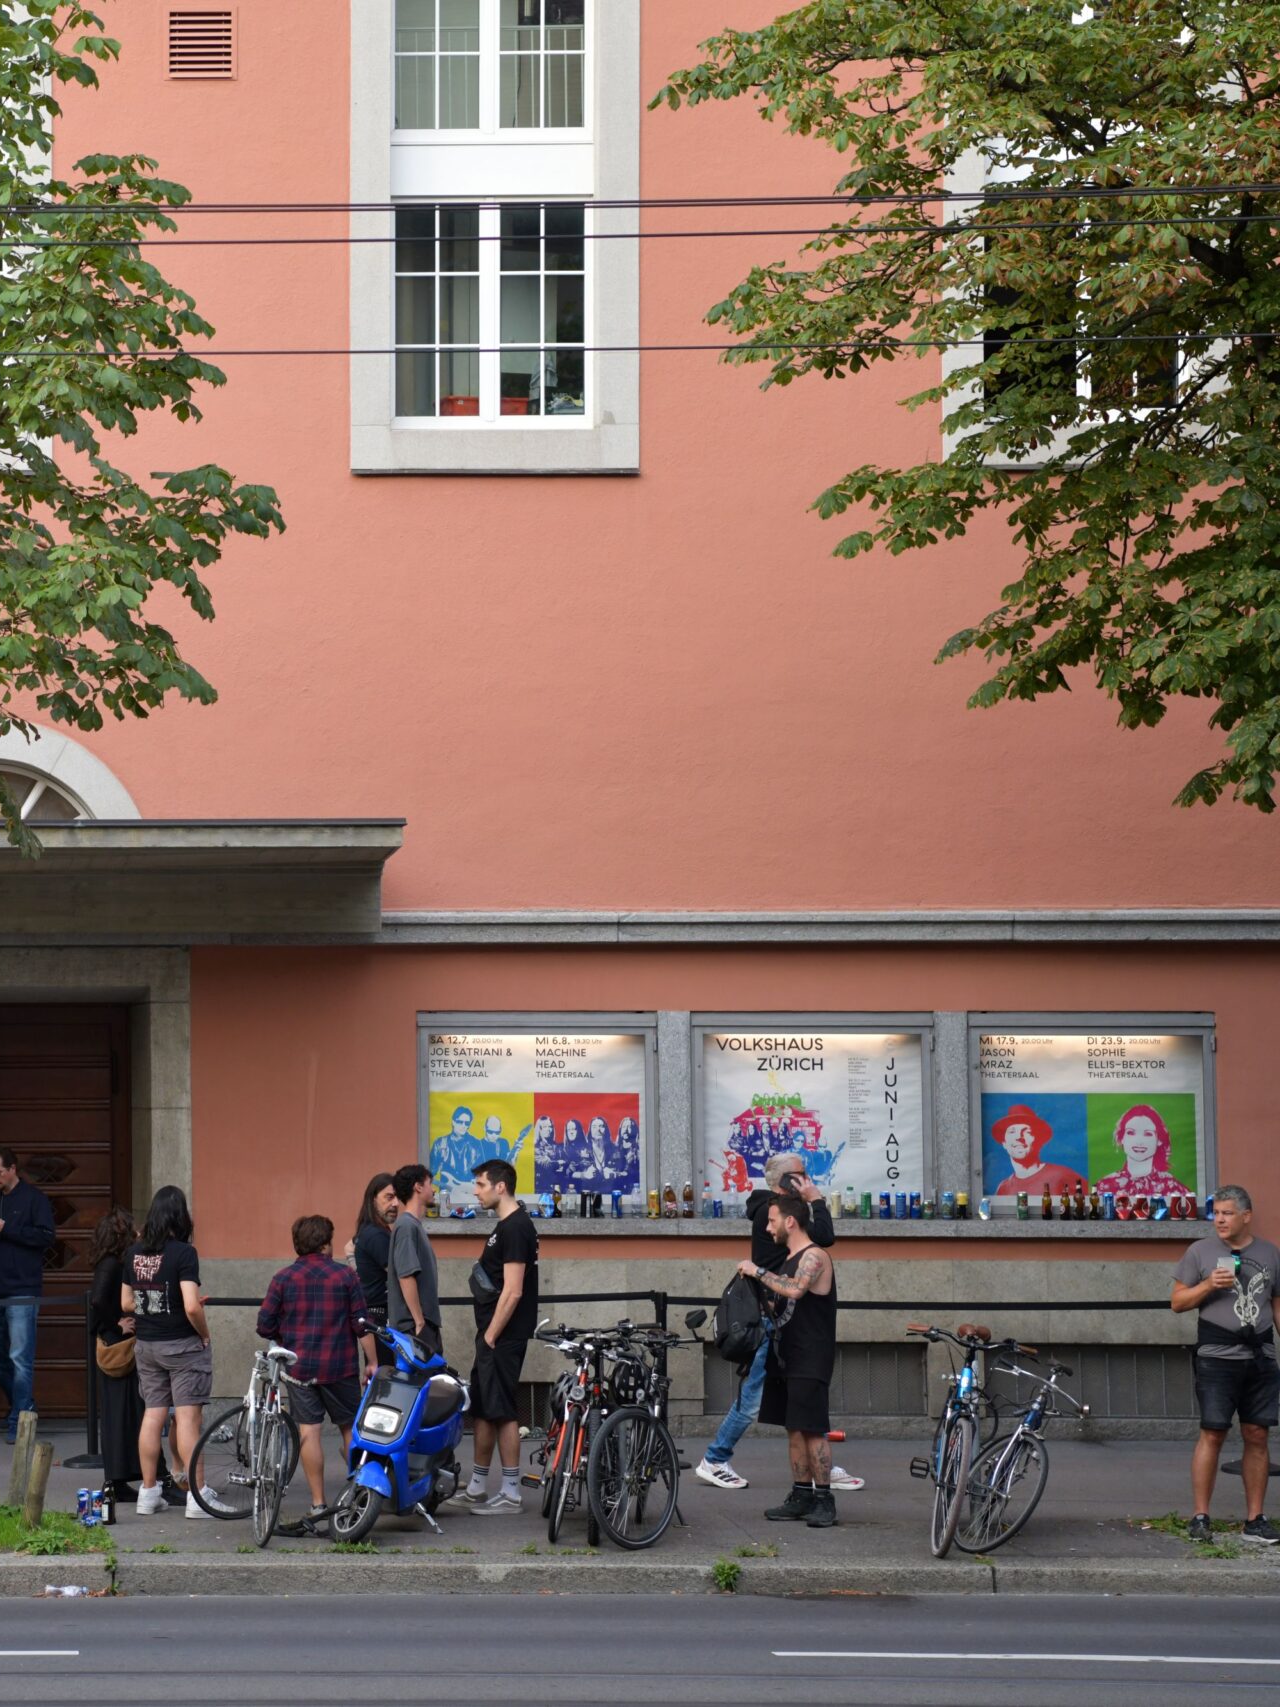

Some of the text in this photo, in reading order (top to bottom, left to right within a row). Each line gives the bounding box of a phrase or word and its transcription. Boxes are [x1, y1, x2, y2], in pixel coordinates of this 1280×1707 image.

[430, 1036, 444, 1045] SA
[447, 1036, 469, 1045] 12.7.
[535, 1037, 549, 1045] MI
[552, 1037, 571, 1045] 6.8.
[716, 1038, 824, 1051] VOLKSHAUS
[979, 1037, 993, 1045] MI
[997, 1037, 1019, 1045] 17.9.
[1087, 1037, 1098, 1045] DI
[1101, 1037, 1126, 1045] 23.9.
[430, 1048, 513, 1056] JOE SATRIANI &
[535, 1049, 587, 1057] MACHINE
[980, 1049, 1015, 1057] JASON
[1088, 1049, 1126, 1057] SOPHIE
[430, 1060, 485, 1068] STEVE VAI
[535, 1060, 566, 1069] HEAD
[757, 1055, 824, 1071] ZÜRICH
[980, 1061, 1013, 1069] MRAZ
[1088, 1061, 1166, 1069] ELLIS-BEXTOR
[133, 1254, 164, 1272] POWER
[136, 1266, 159, 1282] TRIP
